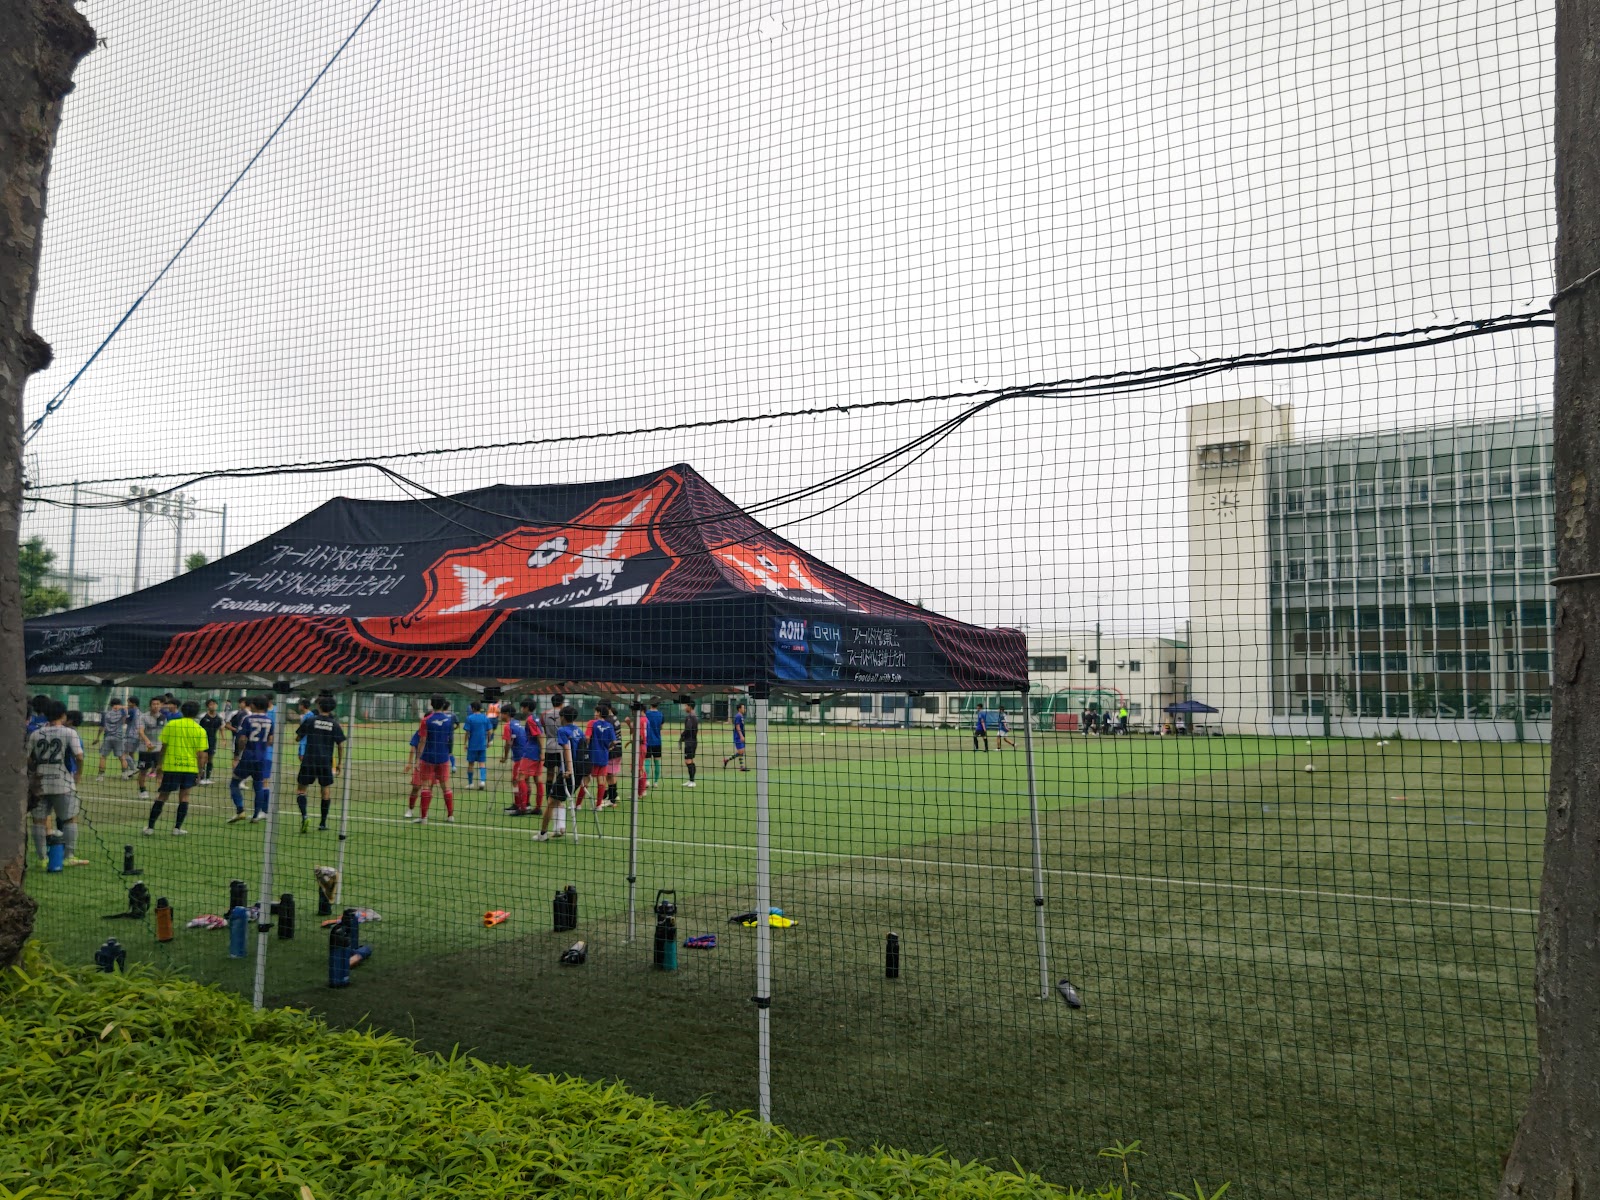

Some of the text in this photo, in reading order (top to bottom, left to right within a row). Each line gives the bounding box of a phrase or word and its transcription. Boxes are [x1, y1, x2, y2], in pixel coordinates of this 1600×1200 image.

[211, 597, 352, 615] Football with Suit
[249, 722, 272, 742] 27
[36, 738, 63, 765] 22
